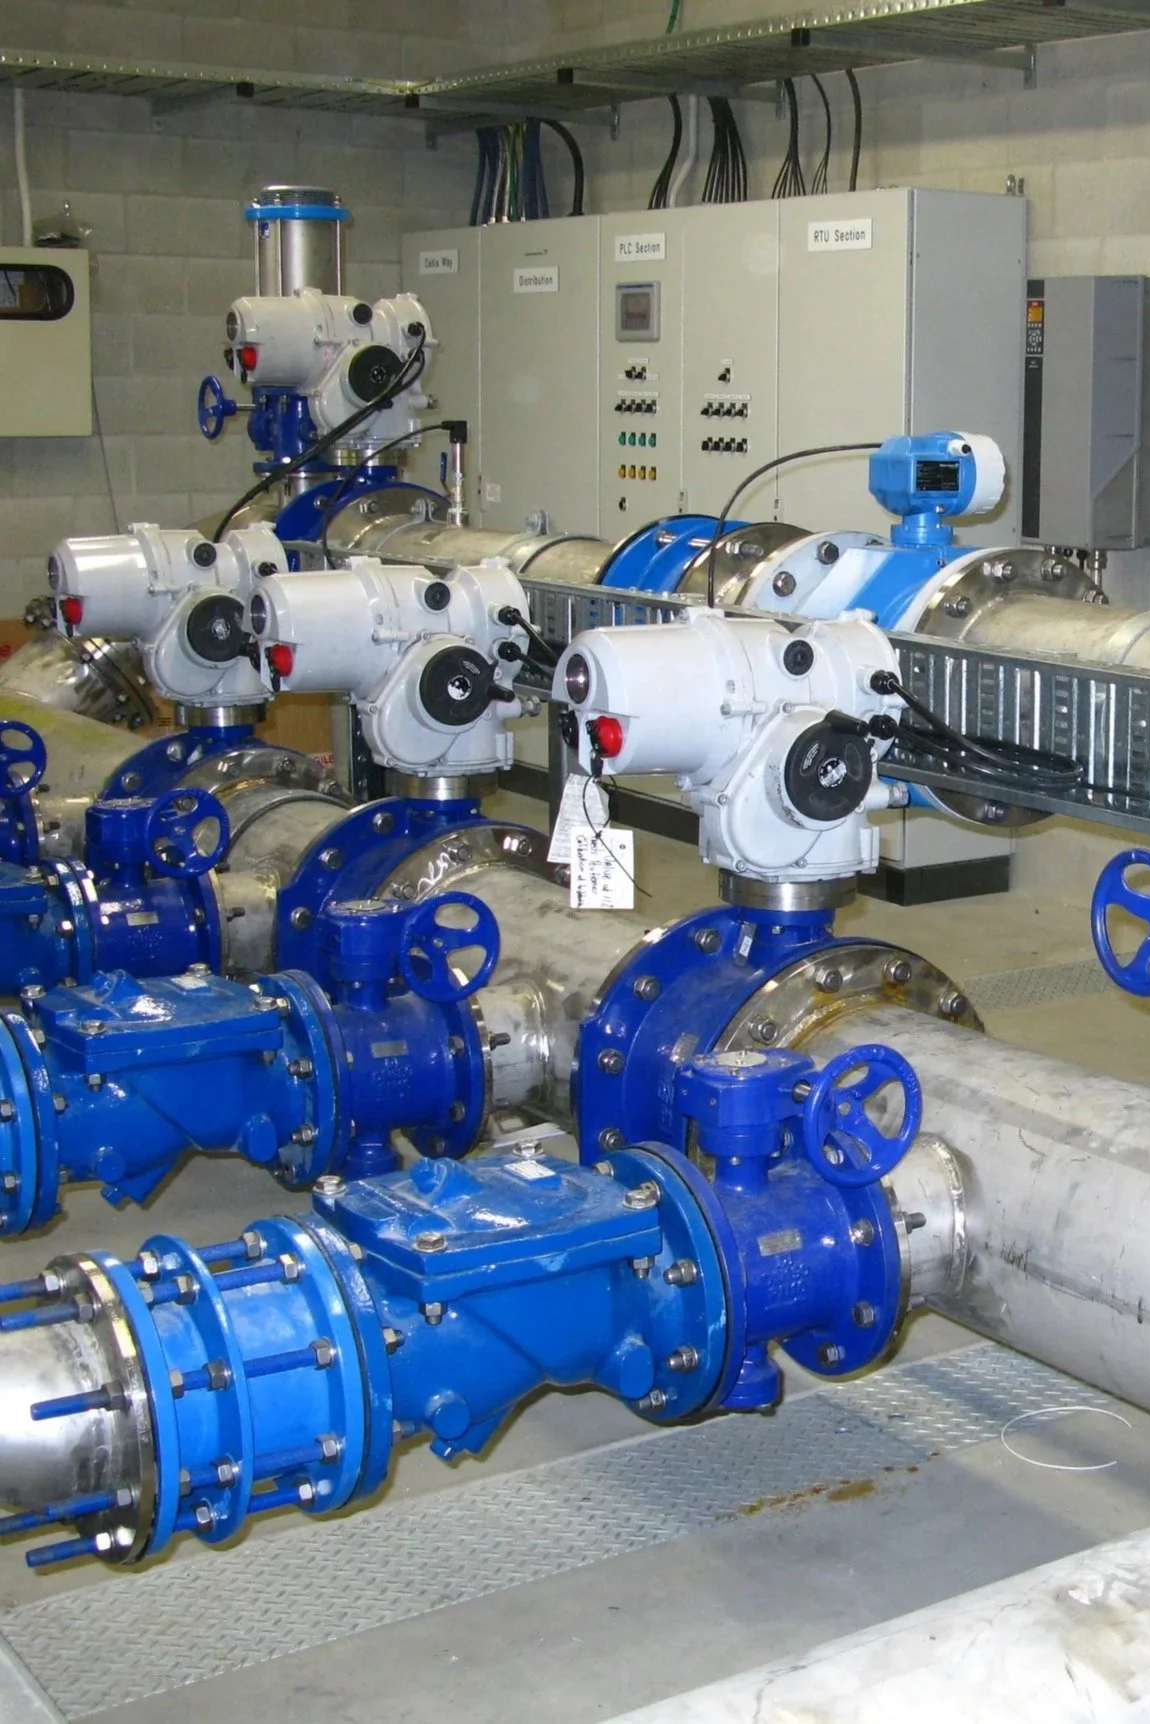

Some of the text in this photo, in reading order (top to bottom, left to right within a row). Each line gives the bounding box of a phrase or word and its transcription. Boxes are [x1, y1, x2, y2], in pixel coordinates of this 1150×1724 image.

[813, 226, 866, 243] RTU Section
[619, 241, 661, 255] PLC Section
[518, 275, 554, 287] Distribution
